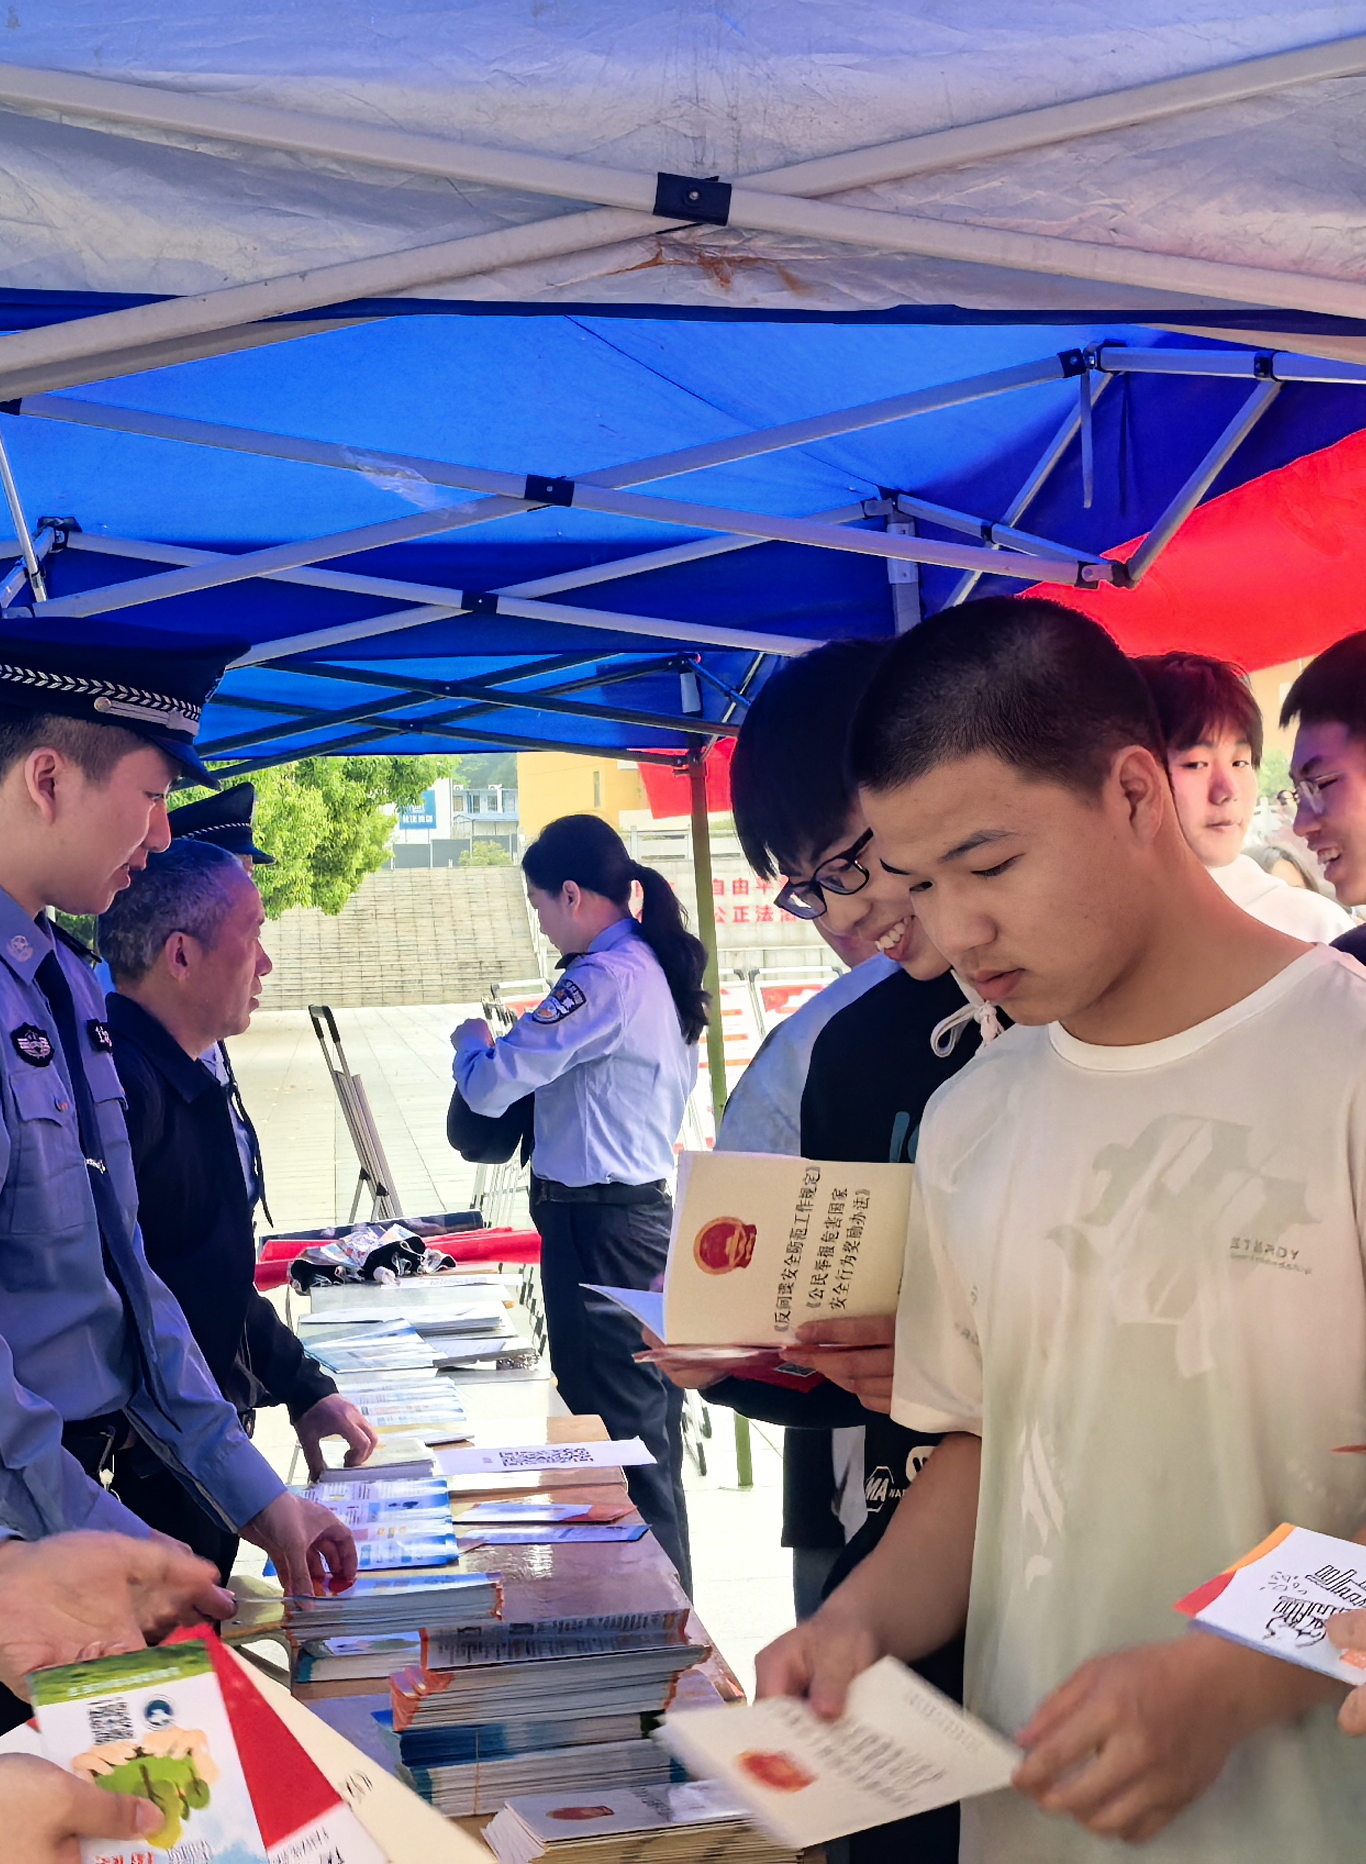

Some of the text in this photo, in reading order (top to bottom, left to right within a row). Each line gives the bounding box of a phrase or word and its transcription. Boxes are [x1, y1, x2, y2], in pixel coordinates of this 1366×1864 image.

[713, 877, 788, 896] 自由平
[774, 1166, 821, 1332] 《反间谍安全防范工作规定》
[806, 1187, 848, 1309] 《公民举报危害国家
[829, 1188, 870, 1310] 安全行为奖励办法》
